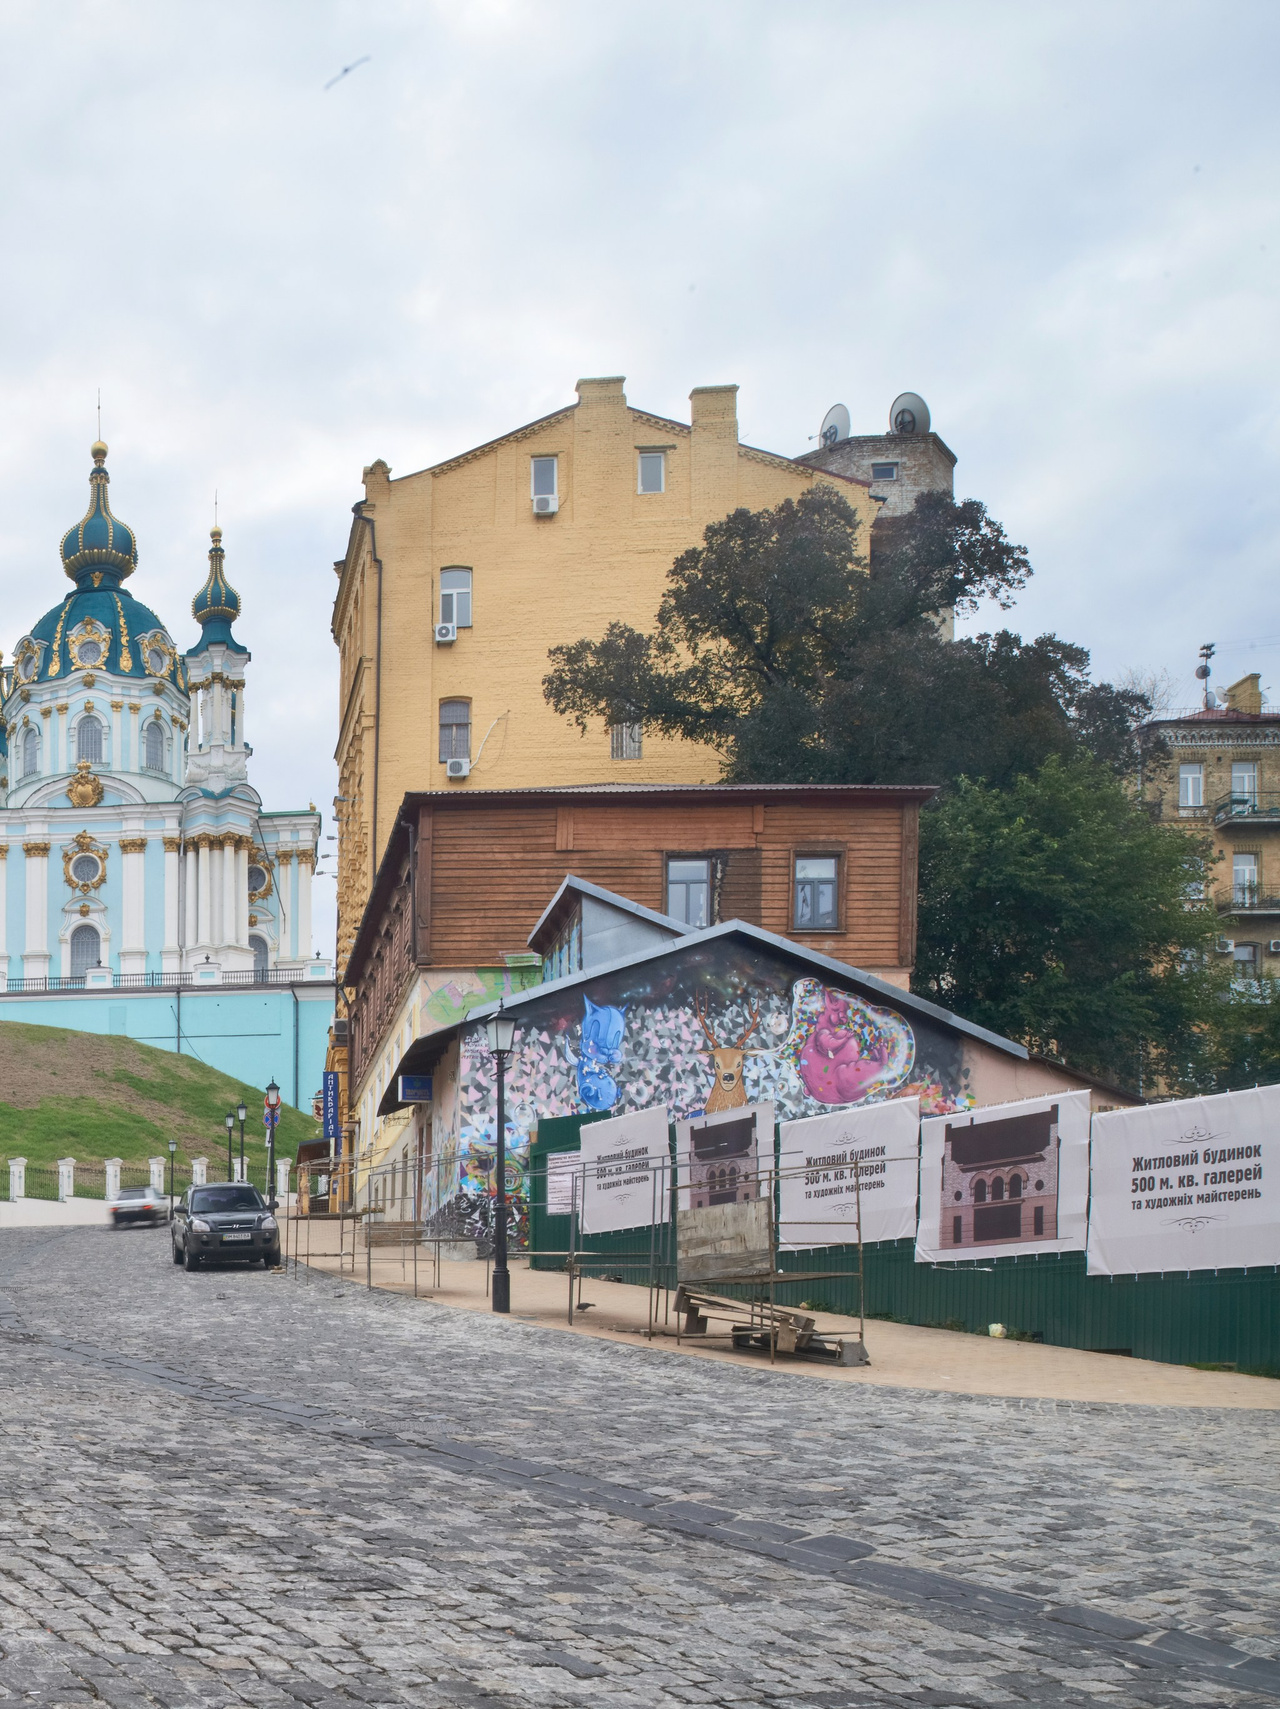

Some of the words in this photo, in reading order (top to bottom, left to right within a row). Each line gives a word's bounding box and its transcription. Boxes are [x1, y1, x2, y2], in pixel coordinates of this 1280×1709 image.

[625, 1146, 649, 1159] будинок
[805, 1150, 847, 1167] Житловий
[849, 1146, 886, 1162] будинок
[1132, 1149, 1199, 1172] Житловий
[1203, 1144, 1262, 1165] будинок
[597, 1183, 602, 1191] та
[602, 1178, 622, 1190] художніх
[623, 1174, 650, 1185] майстерень
[805, 1171, 820, 1185] 500
[822, 1172, 831, 1183] м.
[834, 1170, 847, 1181] кв.
[849, 1161, 886, 1178] галерей
[1131, 1176, 1155, 1193] 500
[1159, 1177, 1173, 1190] м.
[1178, 1174, 1199, 1188] кв.
[1203, 1163, 1263, 1185] галерей
[805, 1191, 812, 1199] та
[813, 1185, 843, 1198] художніх
[1131, 1200, 1142, 1210] та
[1145, 1193, 1193, 1209] художніх
[1196, 1188, 1262, 1204] майстерень
